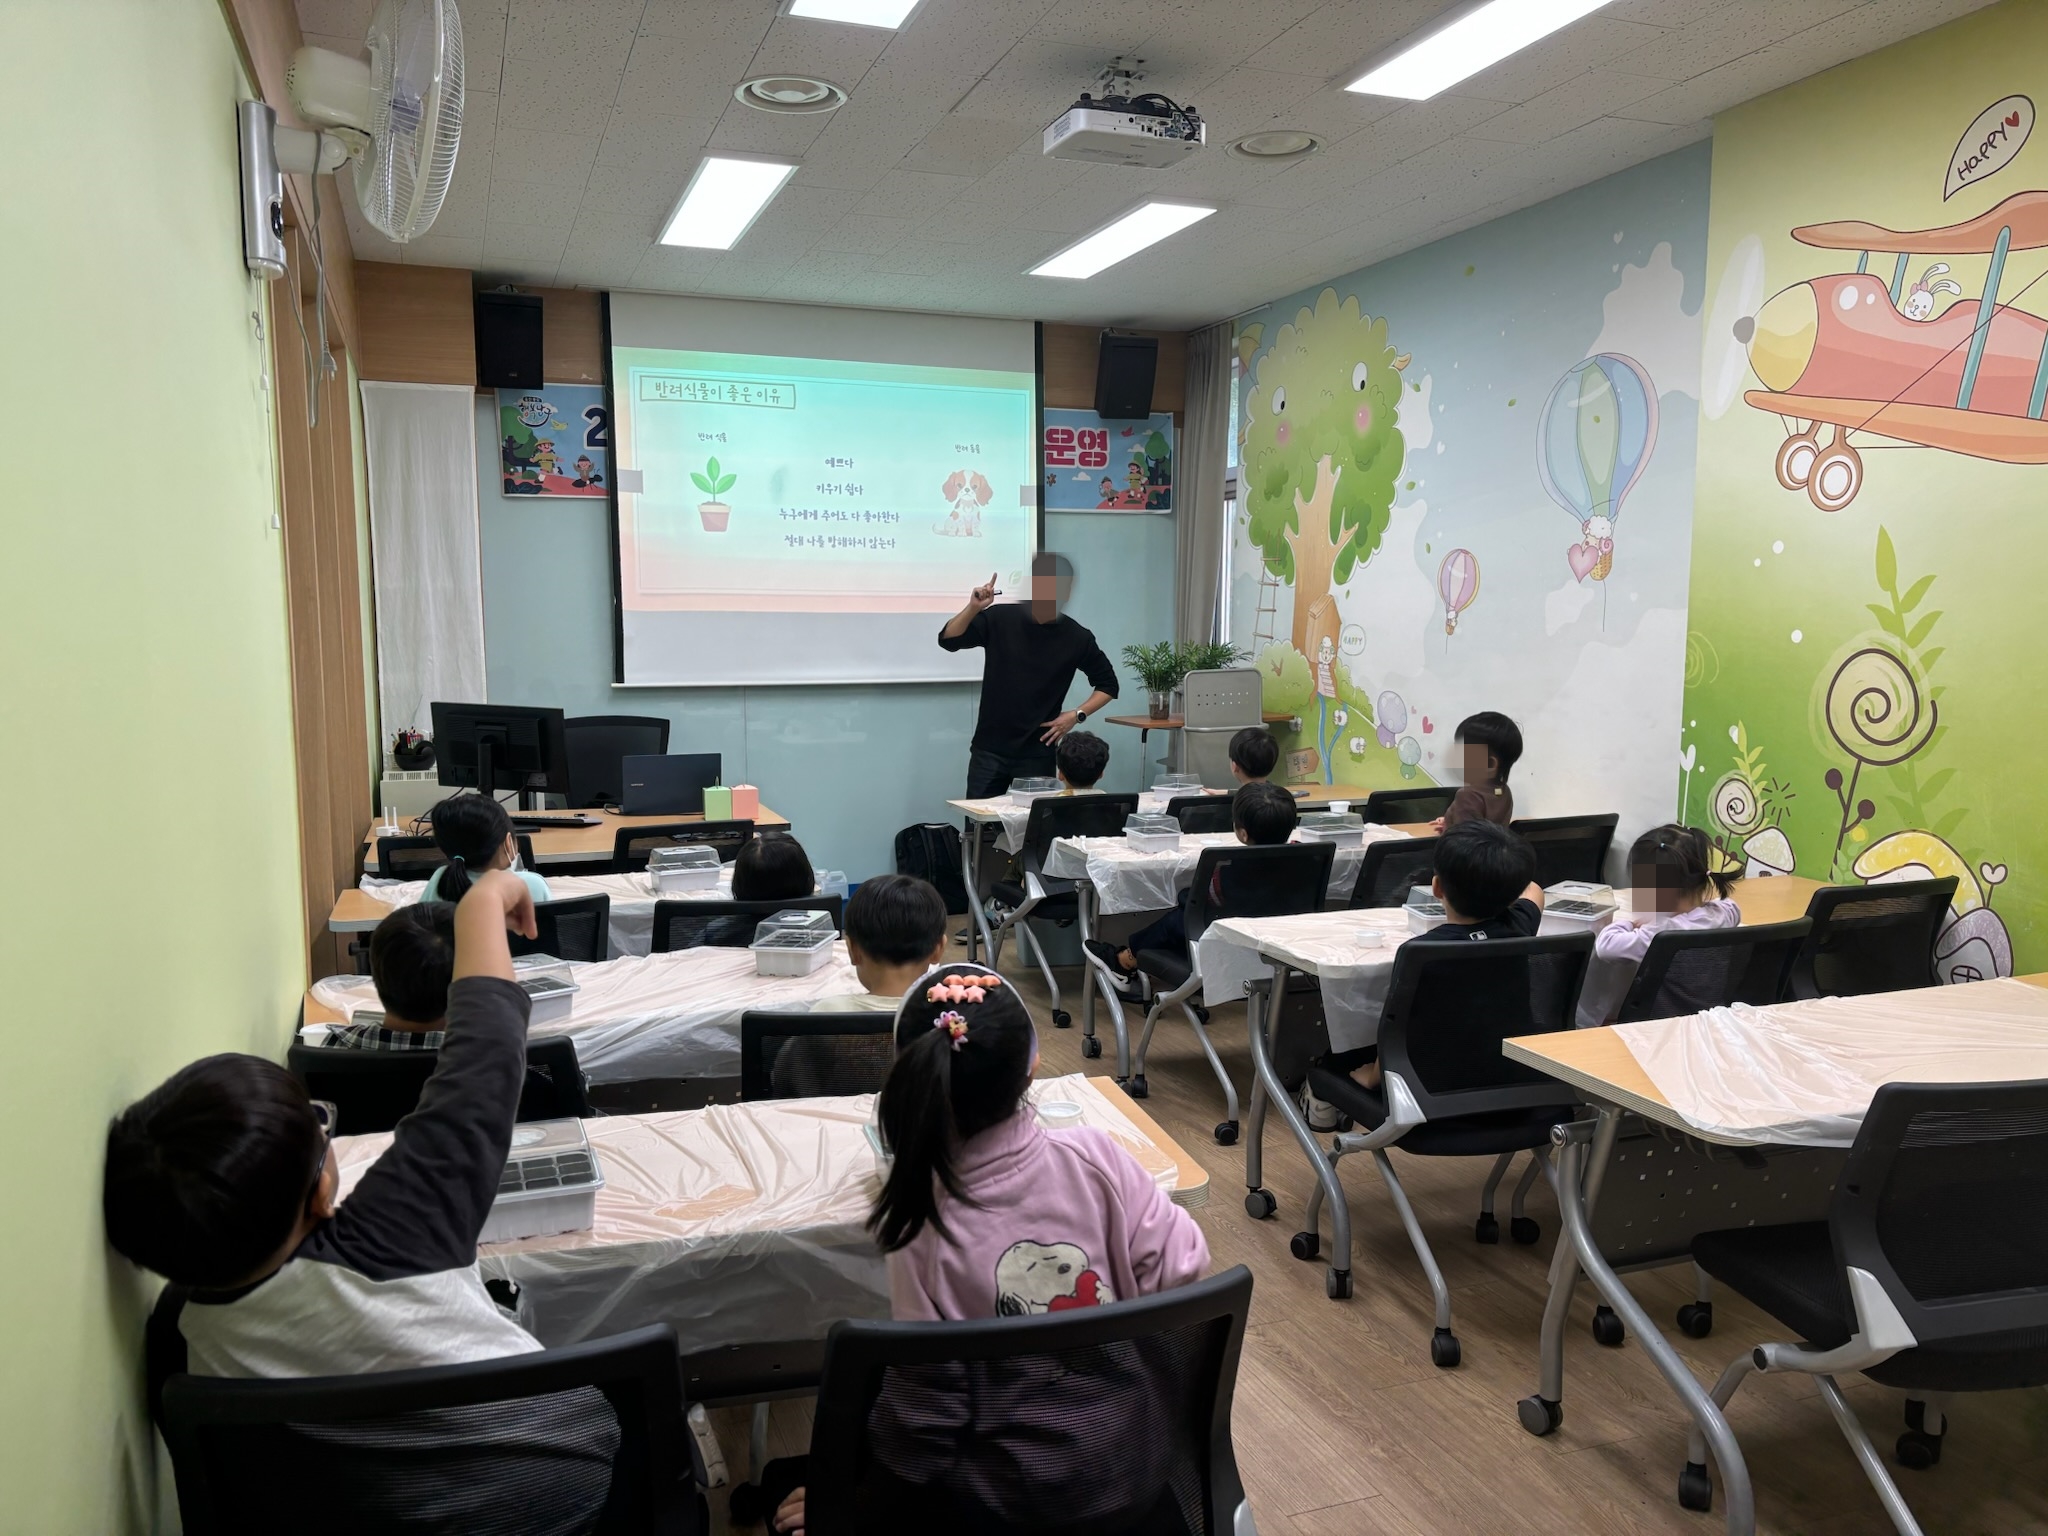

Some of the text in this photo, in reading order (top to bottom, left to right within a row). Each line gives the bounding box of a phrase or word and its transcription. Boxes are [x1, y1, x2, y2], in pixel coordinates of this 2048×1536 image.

[655, 381, 781, 404] 반려식물이 좋은 이유
[1044, 428, 1108, 467] 운영
[825, 457, 854, 469] 예쁘다
[816, 483, 864, 496] 키우기 쉽다
[779, 508, 900, 523] 누구에게 주어도 다 좋아한다
[784, 534, 896, 549] 절대 나를 방해하지 않는다
